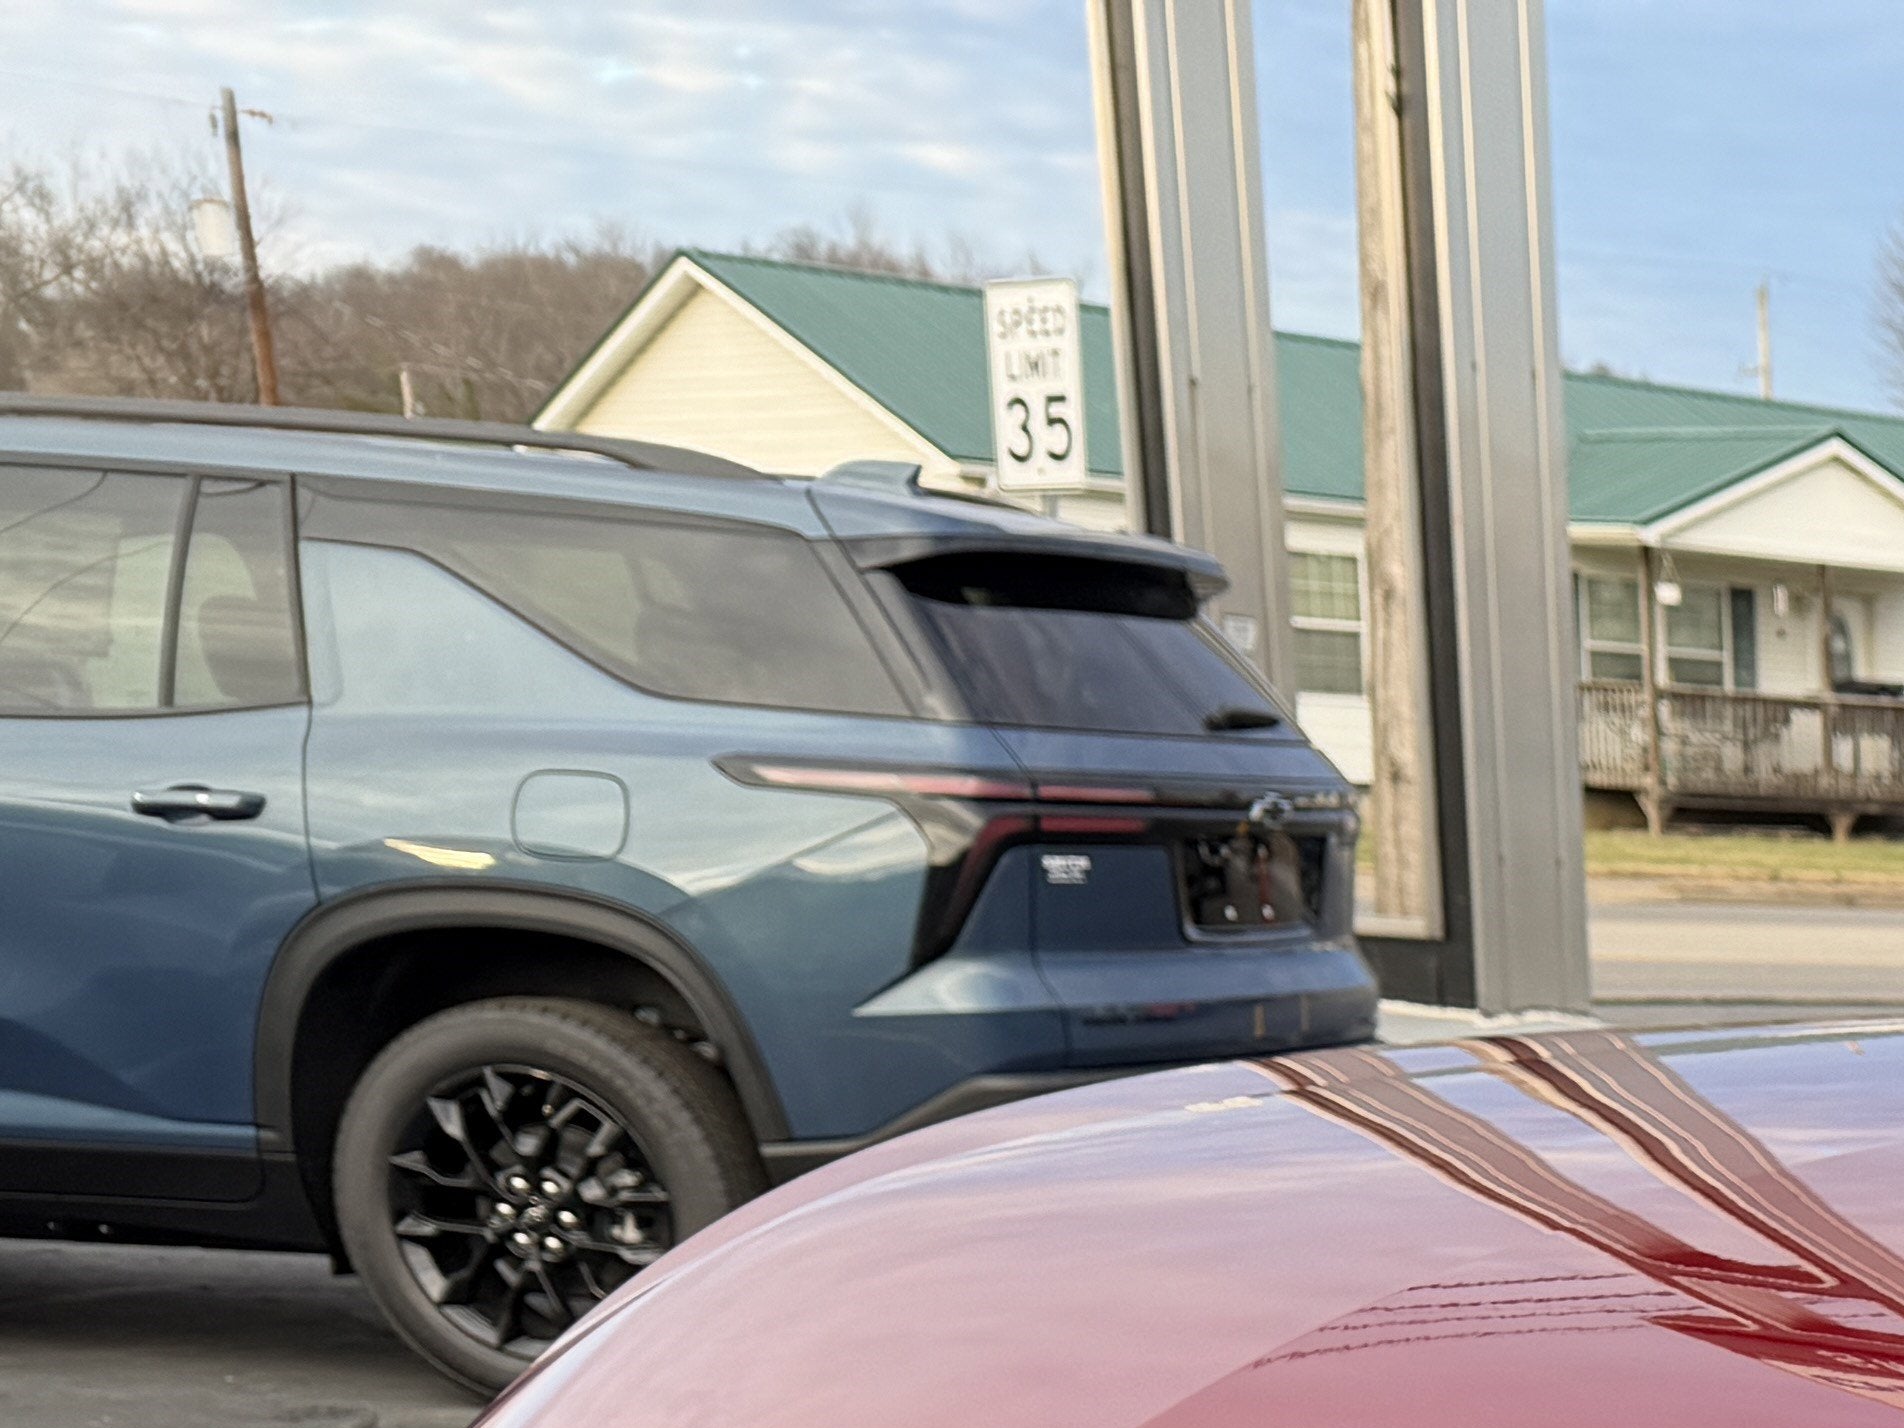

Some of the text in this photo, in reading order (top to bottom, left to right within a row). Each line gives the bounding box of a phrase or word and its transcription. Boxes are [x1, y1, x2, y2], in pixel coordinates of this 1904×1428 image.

[997, 304, 1066, 340] SPEED
[1005, 349, 1062, 381] LIMIT
[1007, 395, 1072, 463] 35
